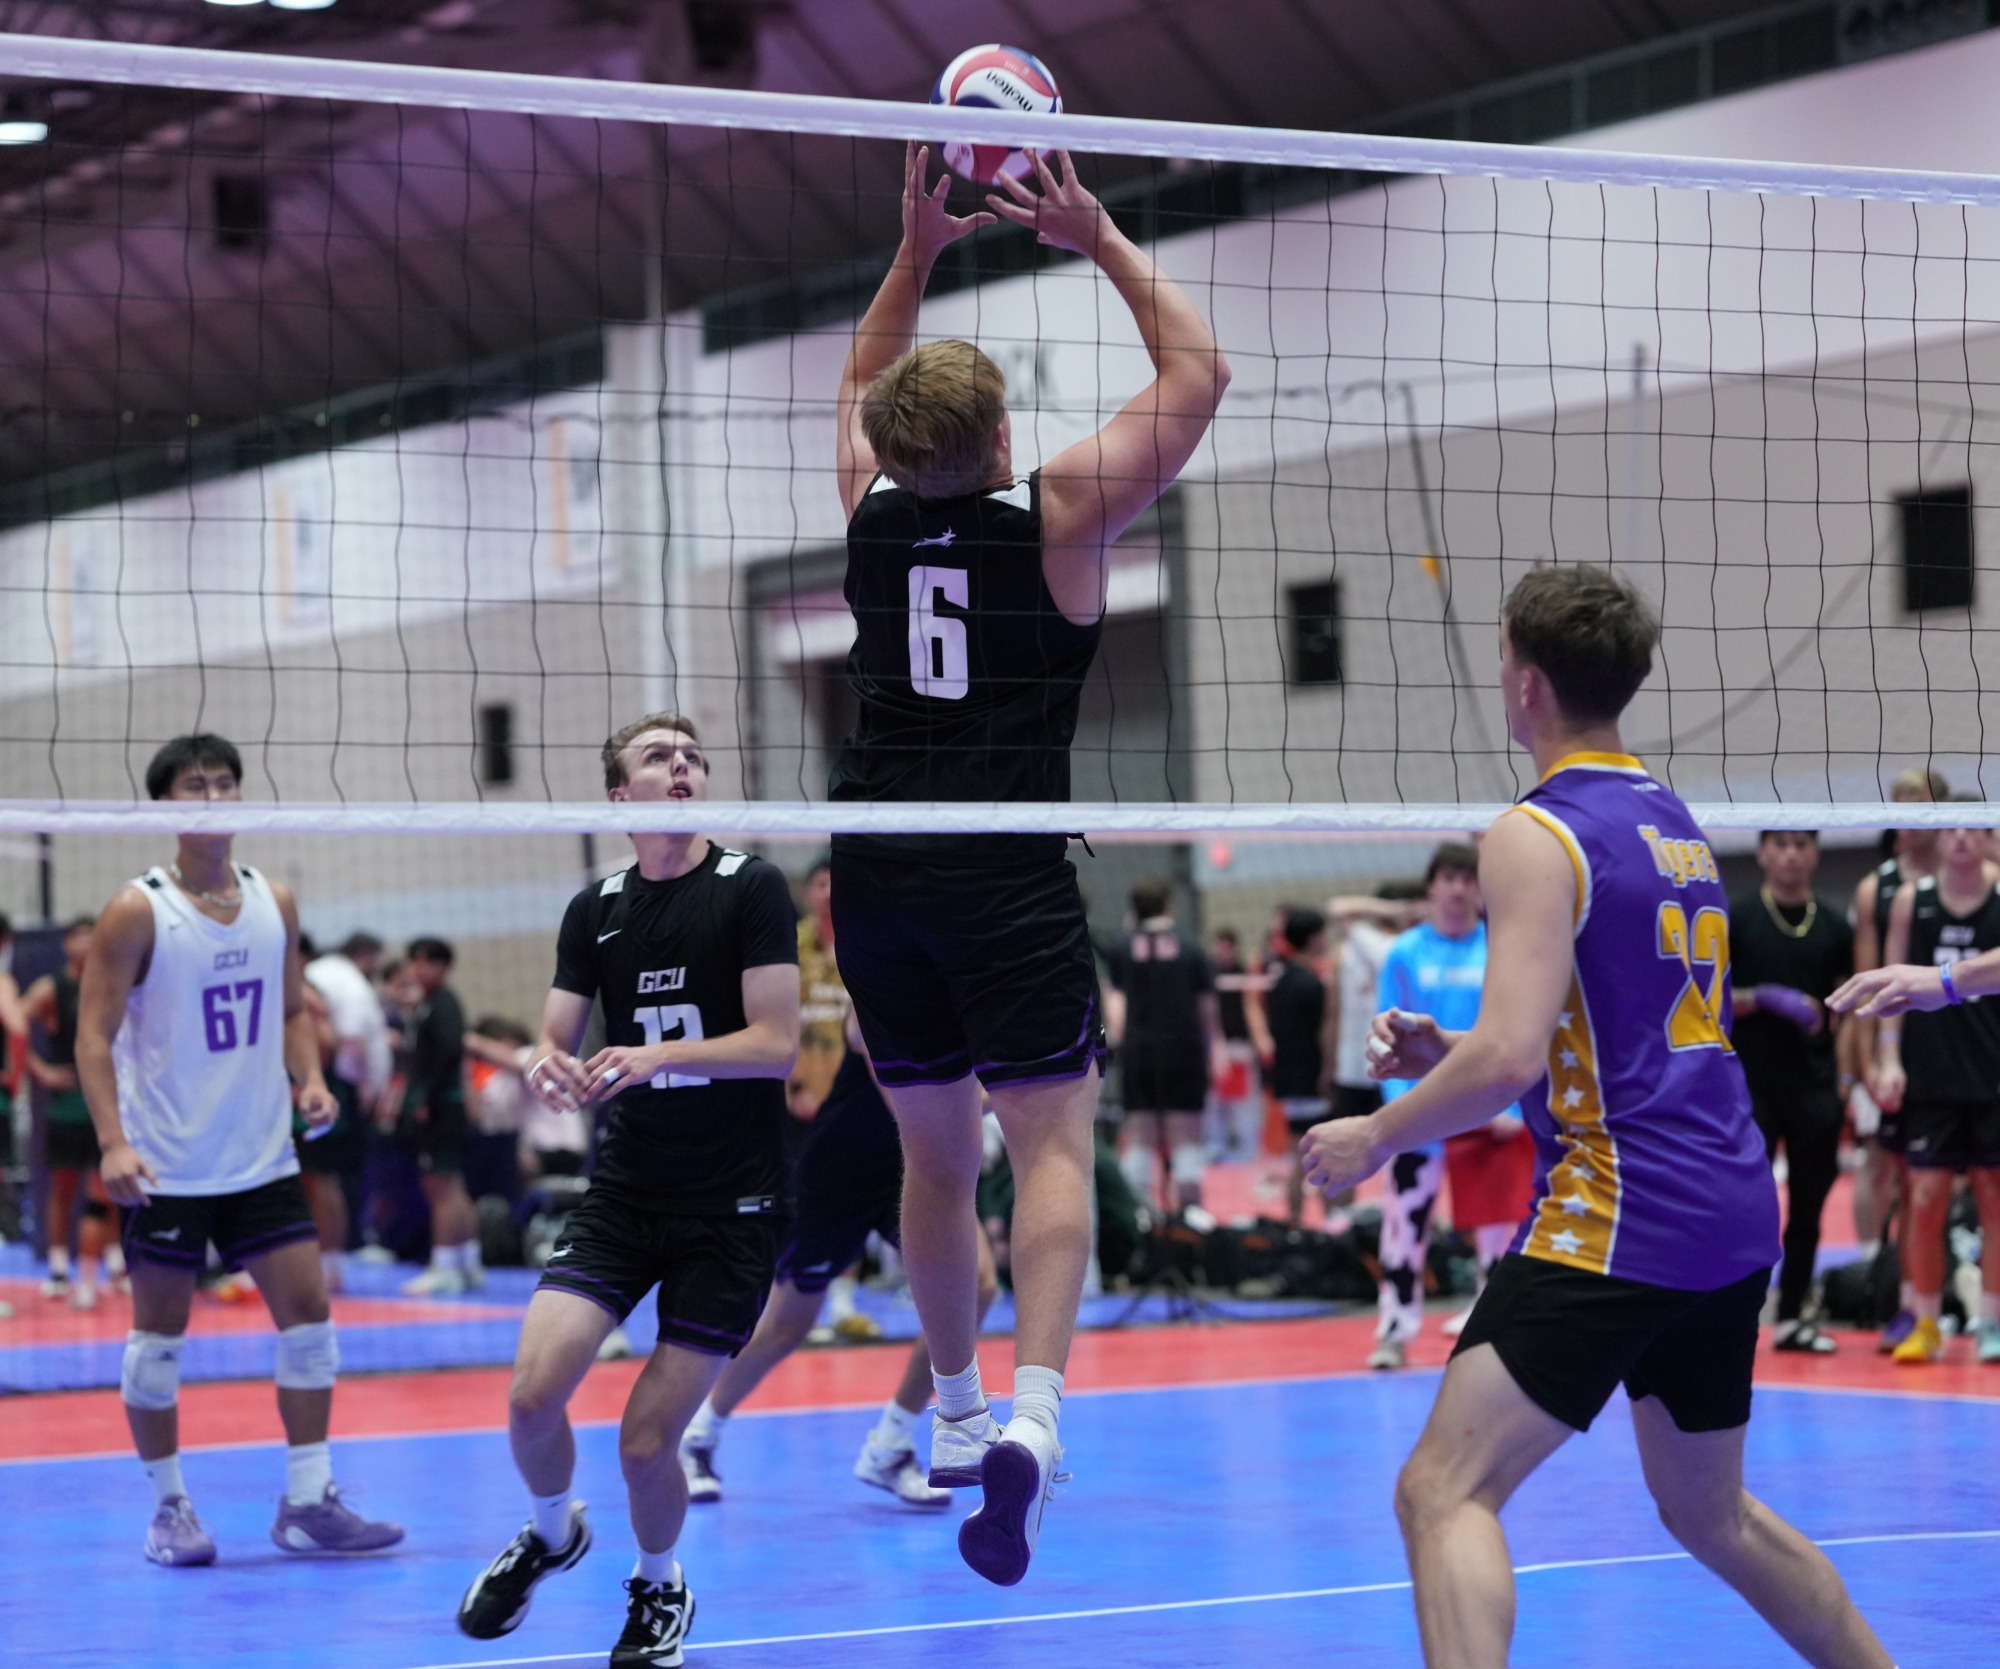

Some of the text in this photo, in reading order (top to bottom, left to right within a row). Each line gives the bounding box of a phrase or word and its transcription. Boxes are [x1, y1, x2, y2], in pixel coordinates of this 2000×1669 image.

[986, 70, 1033, 112] molten
[908, 565, 969, 700] 6
[214, 949, 249, 971] GCU
[637, 966, 687, 993] GCU
[1656, 900, 1736, 1056] 22
[202, 977, 263, 1053] 67
[633, 1003, 711, 1090] 12
